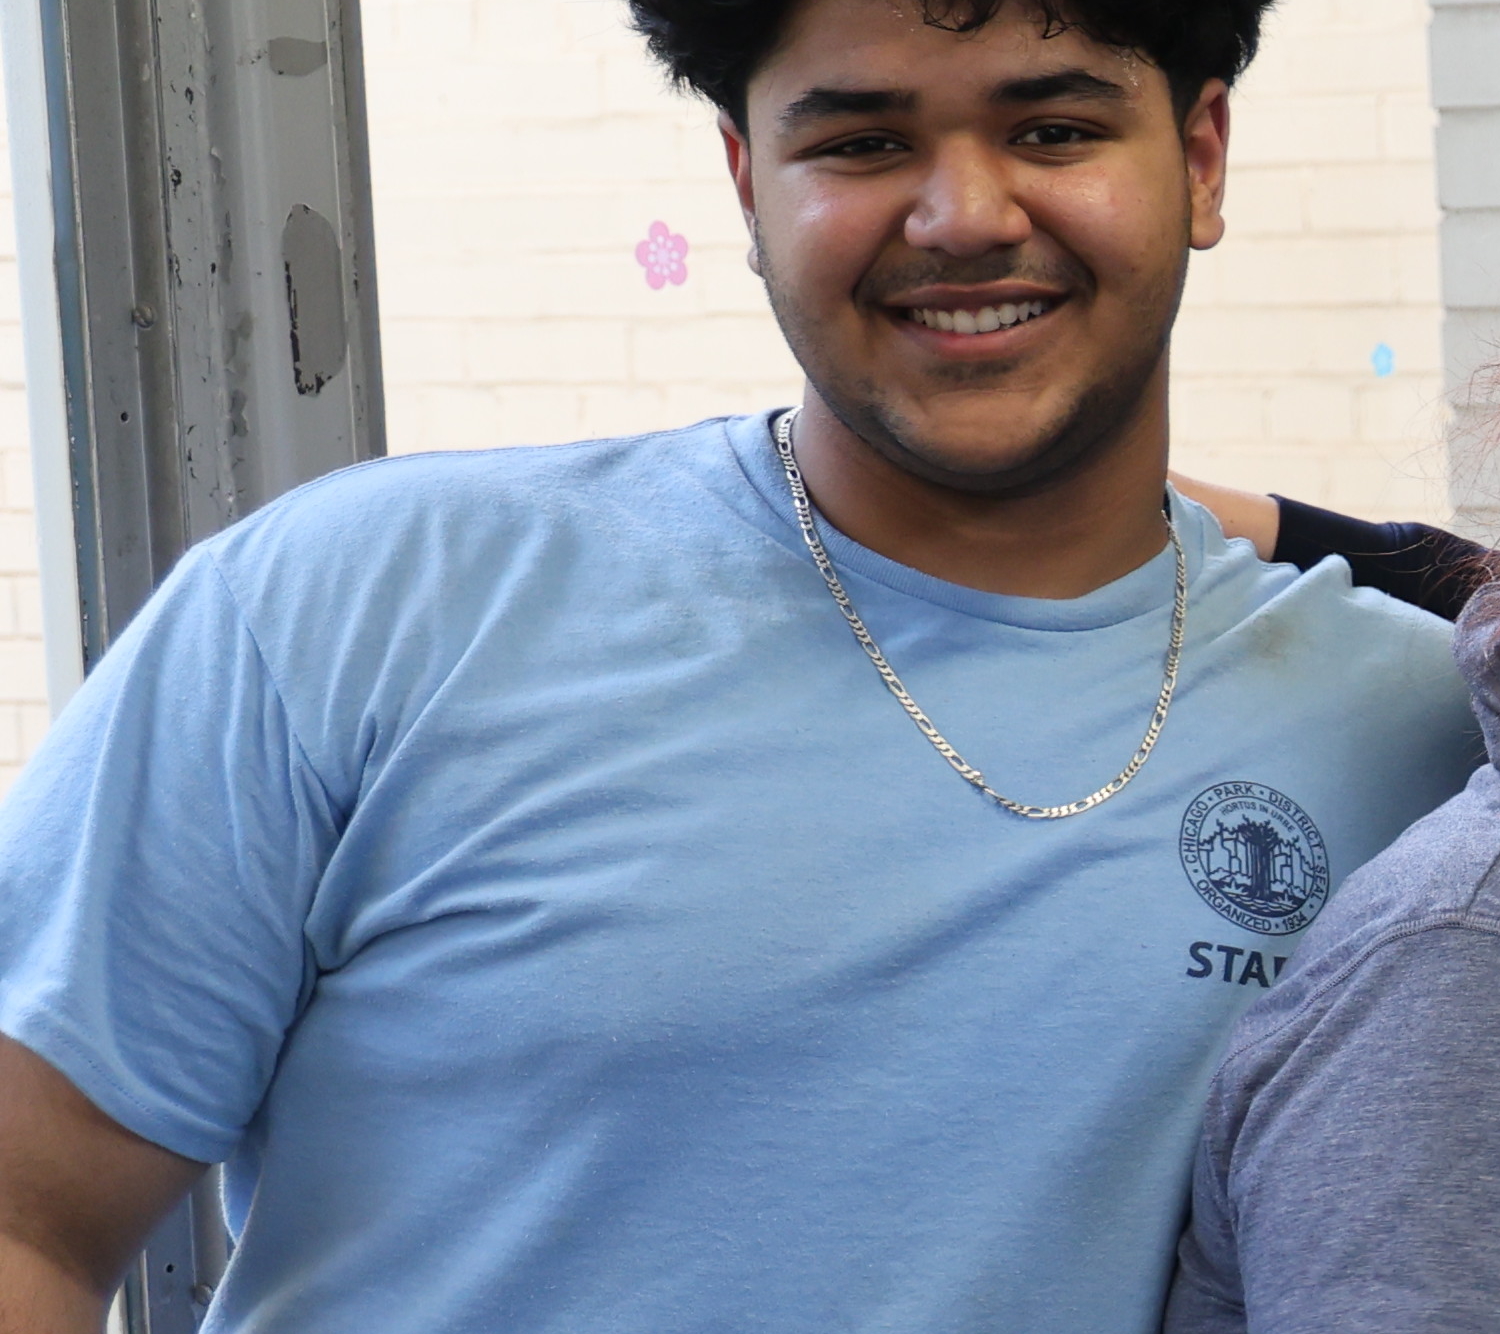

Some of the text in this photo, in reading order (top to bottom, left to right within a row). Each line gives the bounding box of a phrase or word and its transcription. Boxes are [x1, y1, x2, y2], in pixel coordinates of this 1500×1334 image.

[1220, 800, 1257, 816] HORTUS
[1259, 804, 1269, 814] IN
[1185, 784, 1327, 901] CHICAGO PARK DISTRICT SEAL
[1197, 879, 1308, 932] ORGANIZED 1934
[1186, 941, 1288, 988] STA
